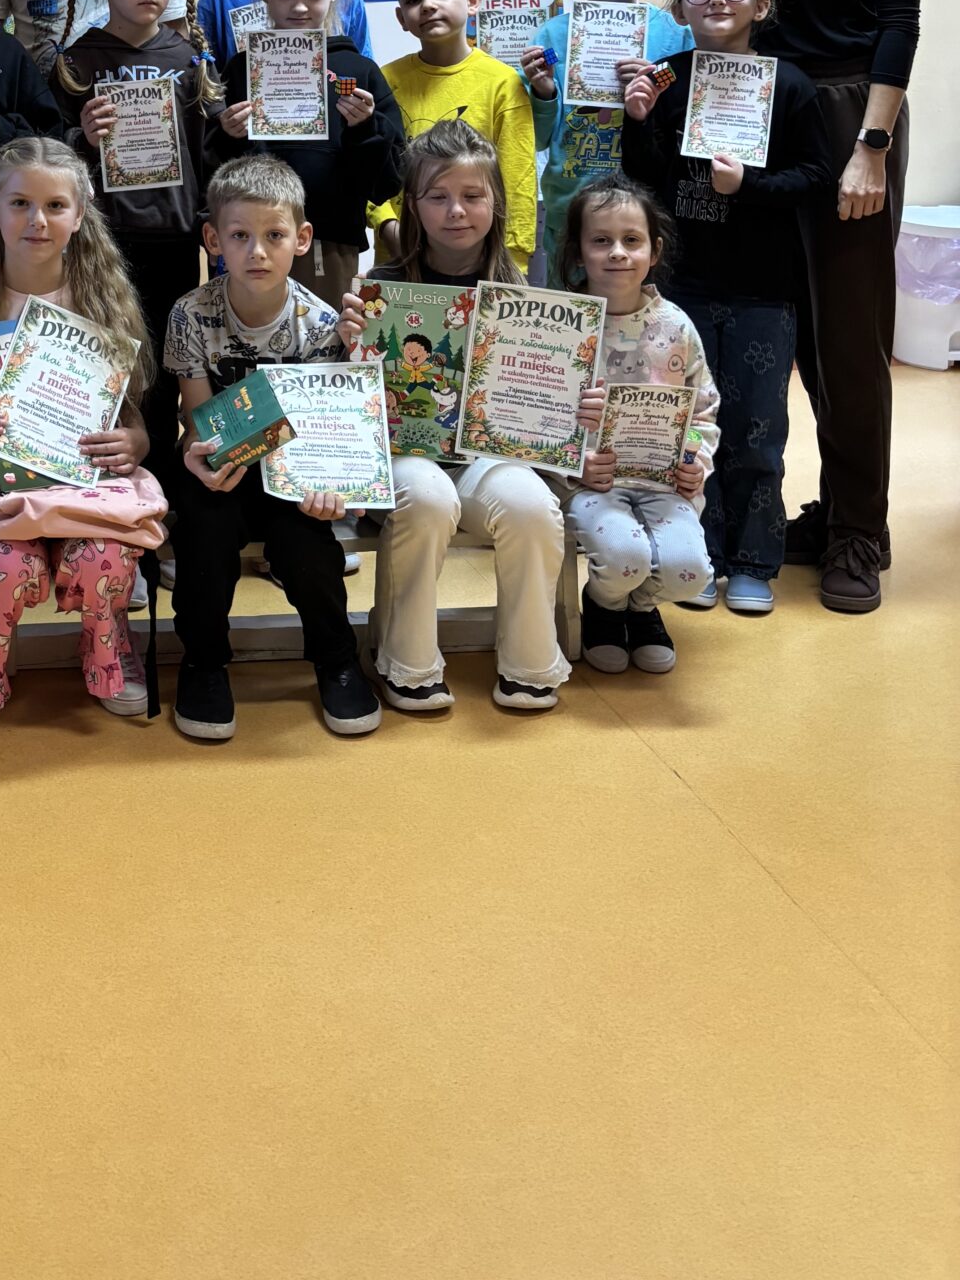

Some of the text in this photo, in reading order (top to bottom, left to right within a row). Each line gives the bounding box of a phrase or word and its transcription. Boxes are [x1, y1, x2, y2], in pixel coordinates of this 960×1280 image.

[490, 15, 538, 29] DYPLOM
[584, 9, 636, 25] DYPLOM
[261, 37, 313, 53] DYPLOM
[708, 61, 763, 80] DYPLOM
[111, 87, 163, 104] DYPLOM
[675, 197, 729, 222] HUGS?
[386, 287, 447, 305] W lesie
[408, 315, 420, 324] 48
[496, 301, 584, 333] DYPLOM
[65, 355, 77, 364] Dla
[500, 355, 566, 375] III miejsca
[527, 351, 552, 362] zajęcie
[57, 371, 83, 389] zajęcie
[281, 373, 365, 394] DYPLOM
[497, 375, 569, 392] plastyczno-technicznym
[507, 370, 535, 381] szkolnym
[535, 374, 565, 384] konkursie
[37, 371, 91, 402] I miejsca
[25, 385, 93, 418] plastyczno-technicznym
[37, 384, 63, 399] szkolnym
[62, 394, 91, 410] konkursie
[621, 391, 680, 407] DYPLOM
[297, 420, 355, 431] II miejsca
[234, 443, 268, 465] Memo
